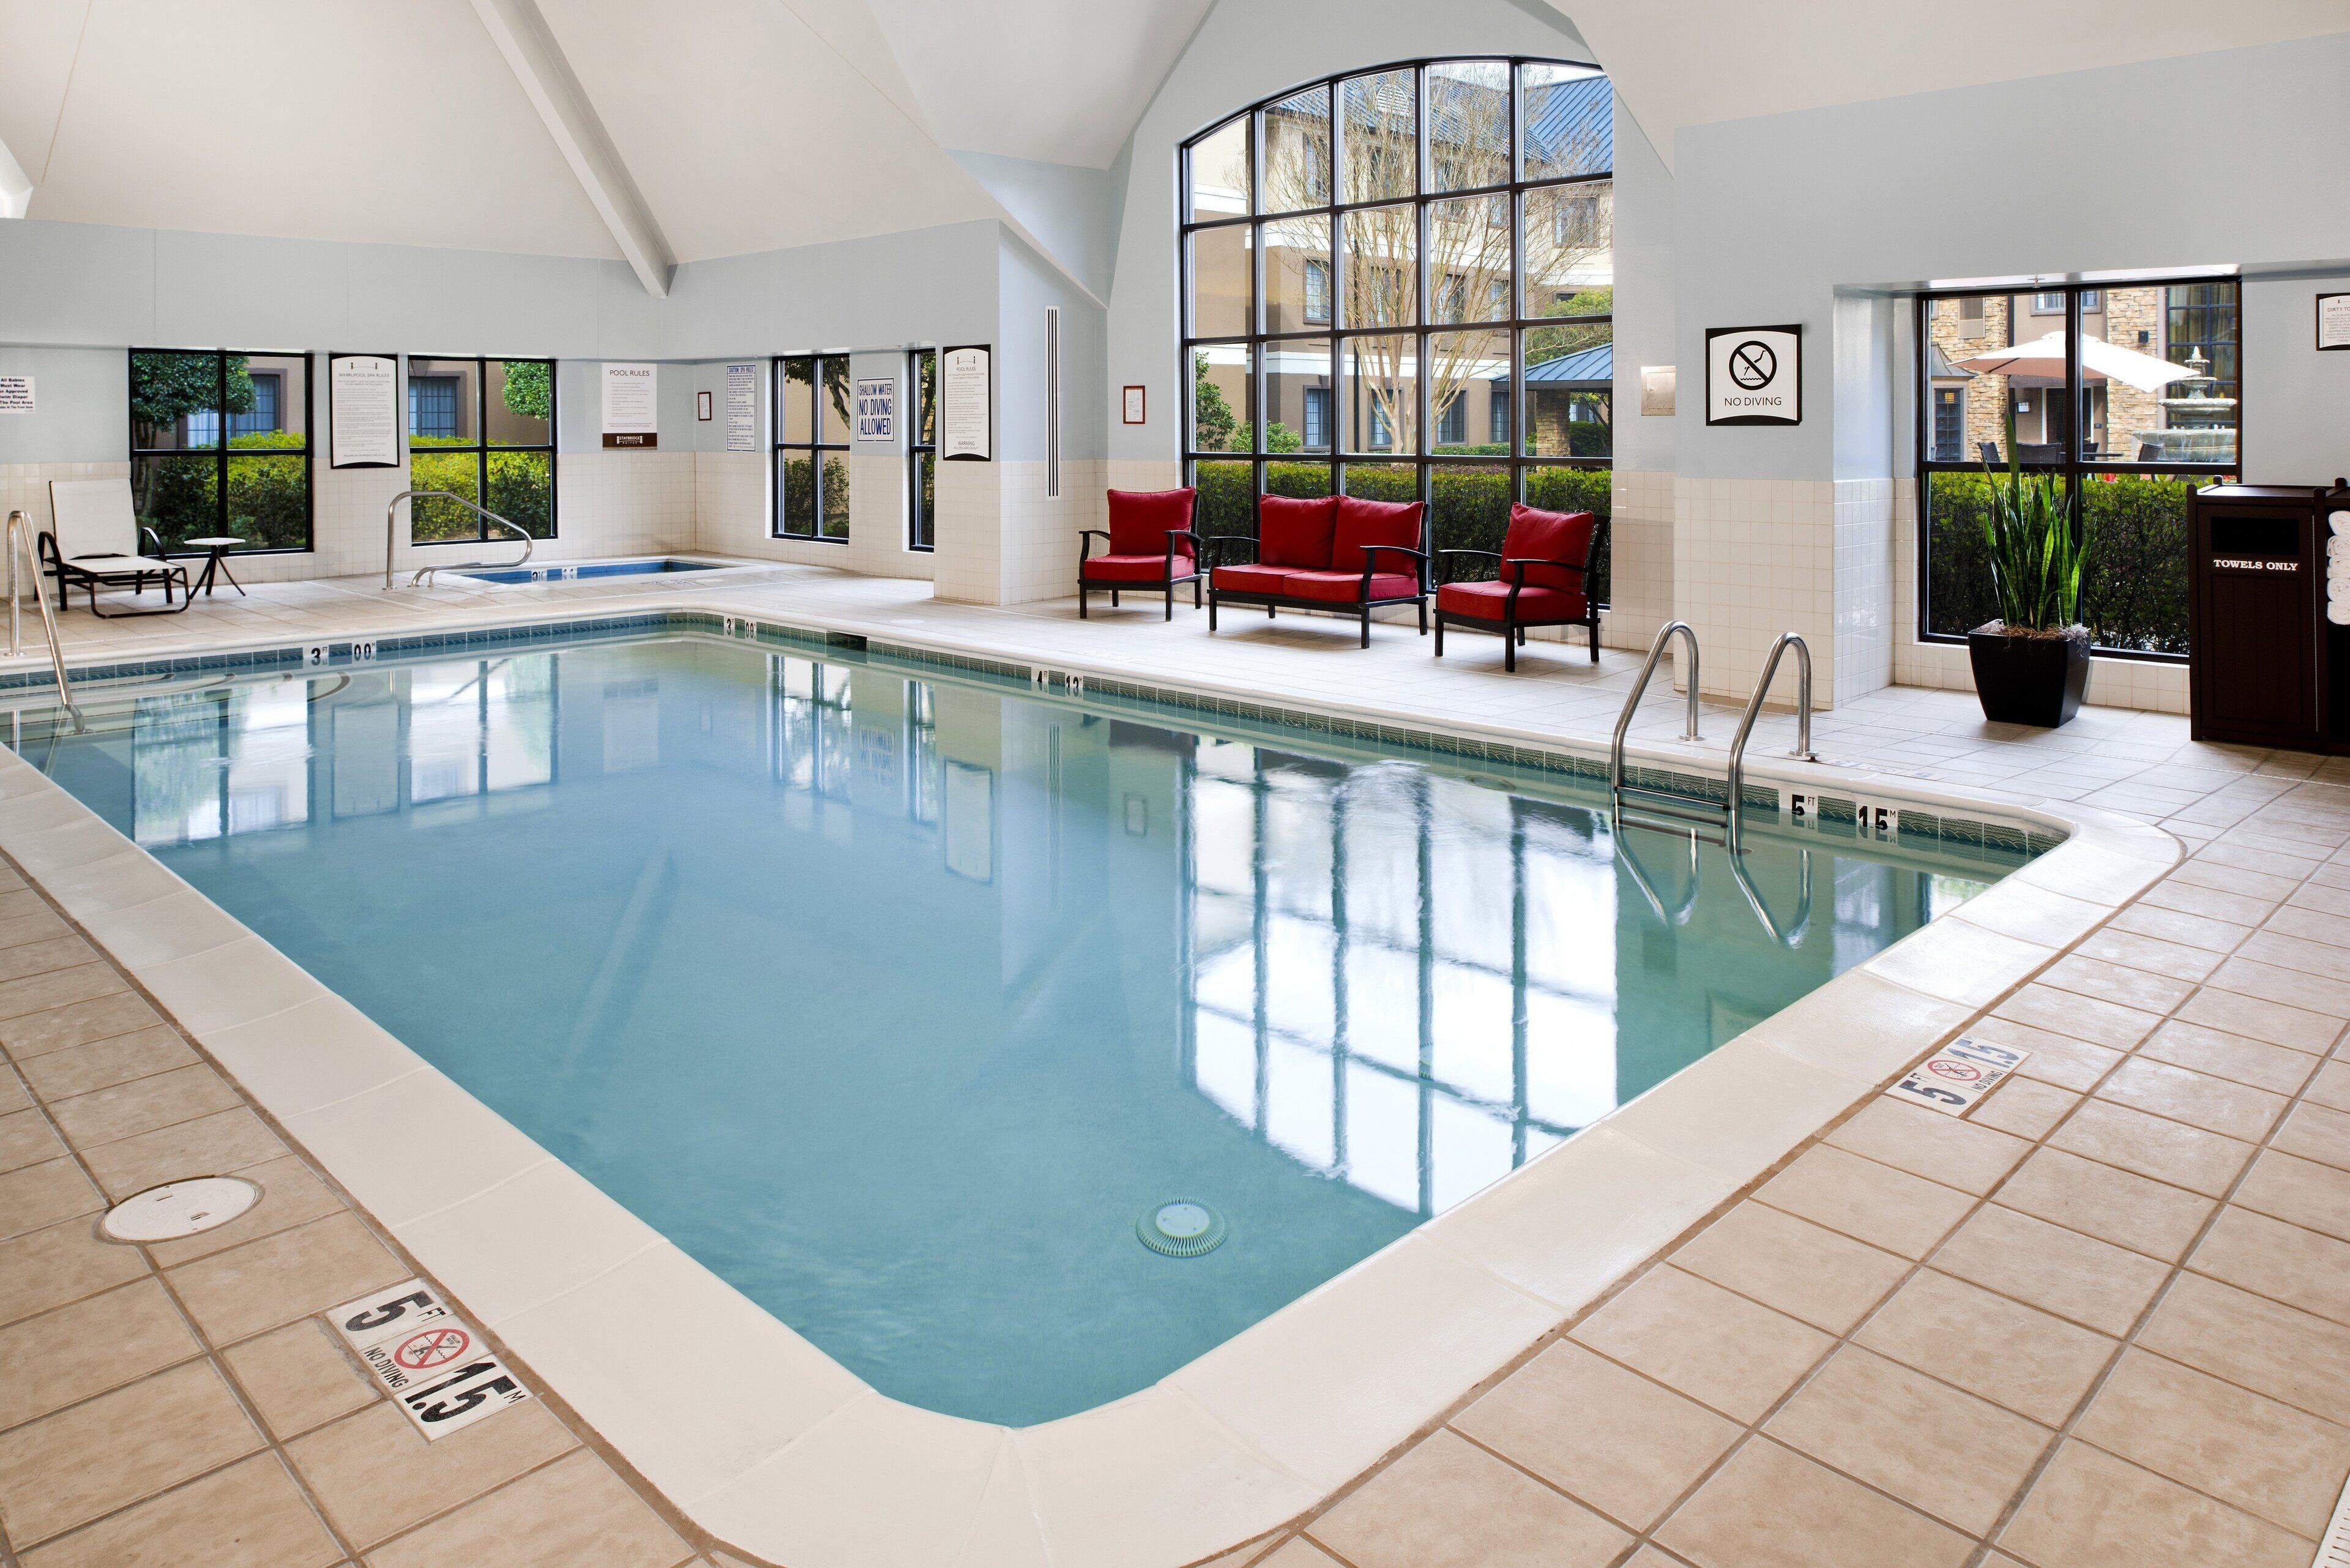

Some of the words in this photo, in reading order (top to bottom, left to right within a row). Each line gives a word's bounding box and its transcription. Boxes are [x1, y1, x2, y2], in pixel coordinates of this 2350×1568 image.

[859, 384, 877, 395] SHALLOW
[878, 384, 892, 395] WATER
[859, 399, 868, 416] NO
[870, 398, 892, 416] DIVING
[1725, 397, 1742, 406] NO
[1744, 397, 1782, 406] DIVING
[860, 418, 891, 435] ALLOWED
[2213, 559, 2263, 569] TOWELS
[2266, 562, 2299, 571] ONLY
[1037, 671, 1042, 684] 4
[1791, 794, 1805, 816] 5
[1808, 796, 1815, 806] FT
[1947, 1038, 2019, 1069] 1.5
[1909, 1072, 1931, 1083] FT
[1971, 1082, 1985, 1091] NO
[1984, 1070, 2004, 1088] DIVING
[1898, 1080, 1967, 1105] 5
[345, 1290, 435, 1332] 5
[417, 1307, 447, 1322] FT
[364, 1346, 386, 1361] NO
[375, 1358, 409, 1388] DIVING
[405, 1362, 518, 1423] 1.5
[504, 1390, 526, 1404] M
